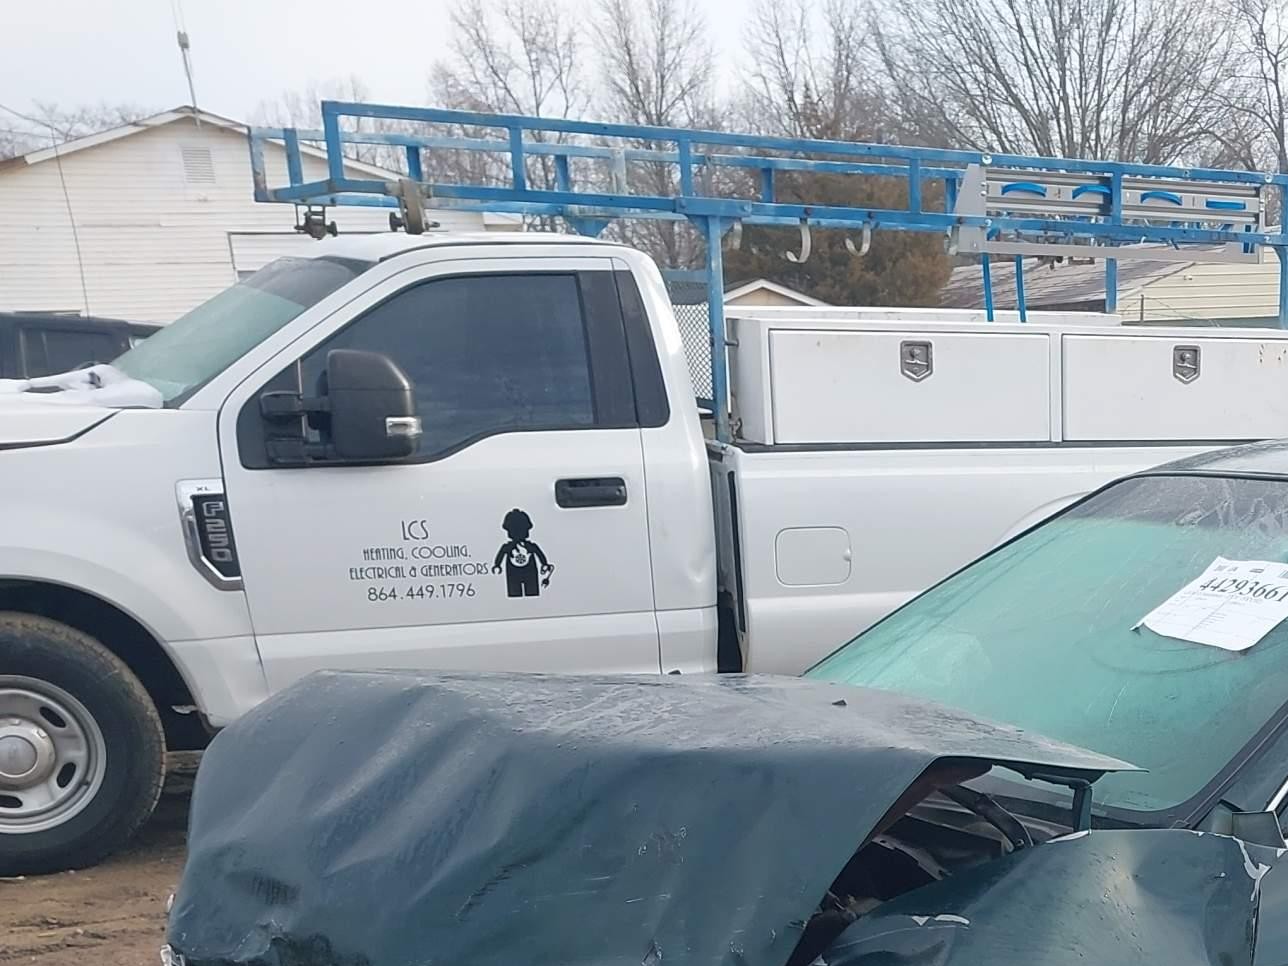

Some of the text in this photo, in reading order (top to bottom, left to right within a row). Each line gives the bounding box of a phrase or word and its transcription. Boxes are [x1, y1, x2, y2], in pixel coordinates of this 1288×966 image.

[201, 500, 233, 562] F250
[401, 519, 430, 541] LCS
[349, 565, 407, 581] ELECTRICAL
[420, 562, 489, 578] GENERATORS
[367, 582, 477, 602] 864.449.1796
